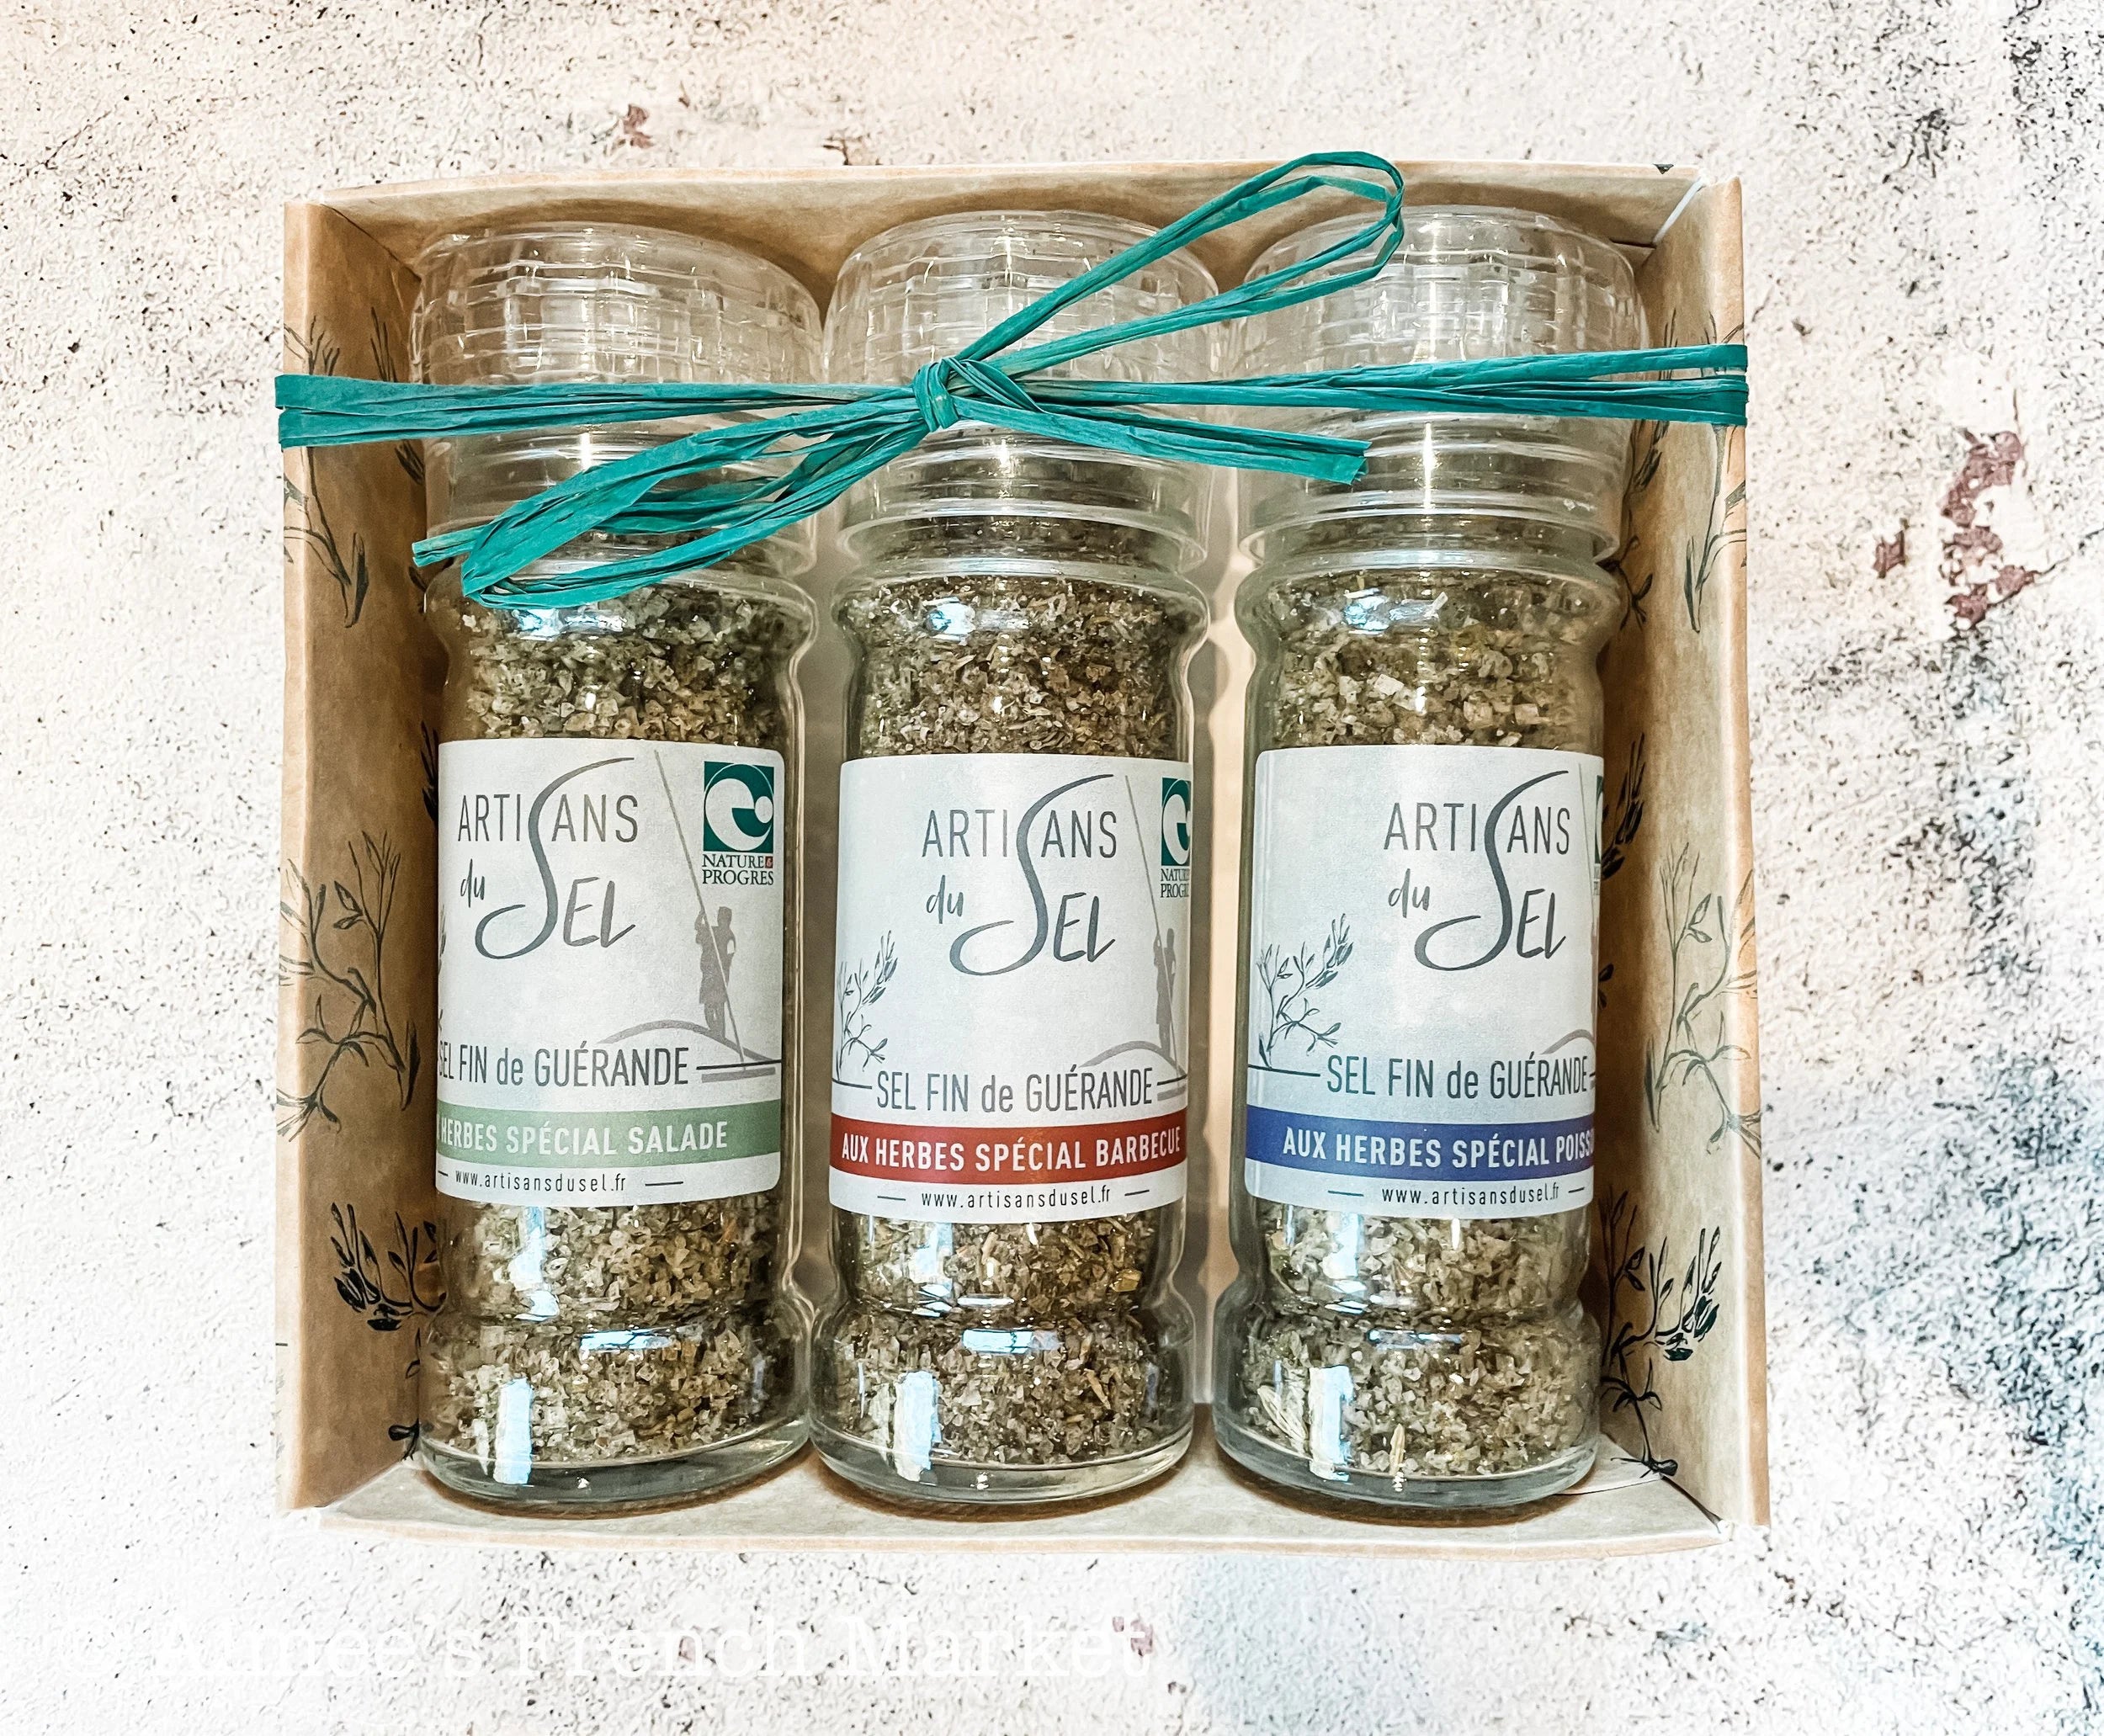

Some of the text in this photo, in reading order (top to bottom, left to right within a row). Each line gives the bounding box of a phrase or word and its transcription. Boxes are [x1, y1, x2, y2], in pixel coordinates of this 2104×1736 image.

[457, 793, 639, 843] ARTISANS
[922, 809, 1117, 858] ARTISANS
[1383, 802, 1570, 856] ARTISANS
[460, 858, 486, 908] du
[702, 854, 764, 868] NATURE
[702, 869, 774, 885] PROGRES
[925, 874, 965, 925] du
[1387, 868, 1431, 918] du
[460, 1043, 487, 1084] FIN
[496, 1047, 523, 1086] de
[534, 1040, 690, 1087] GUÉRANDE
[1326, 1051, 1588, 1100] SEL FIN de GUÉRANDE
[877, 1064, 1153, 1113] SEL FIN de GUÉRANDE
[441, 1117, 497, 1152] HERBES
[506, 1122, 619, 1156] SPÉCIAL
[628, 1120, 728, 1155] SALADE
[841, 1126, 1181, 1172] AUX HERBES SPÉCIAL BARBECUE
[1283, 1127, 1327, 1160] AUX
[1336, 1133, 1442, 1169] HERBES
[1452, 1131, 1549, 1169] SPÉCIAL
[454, 1169, 627, 1193] www.artisansdusel.fr
[921, 1184, 1111, 1210] www.artisansdusel.fr
[1381, 1181, 1559, 1206] www.artisansdusel.fr
